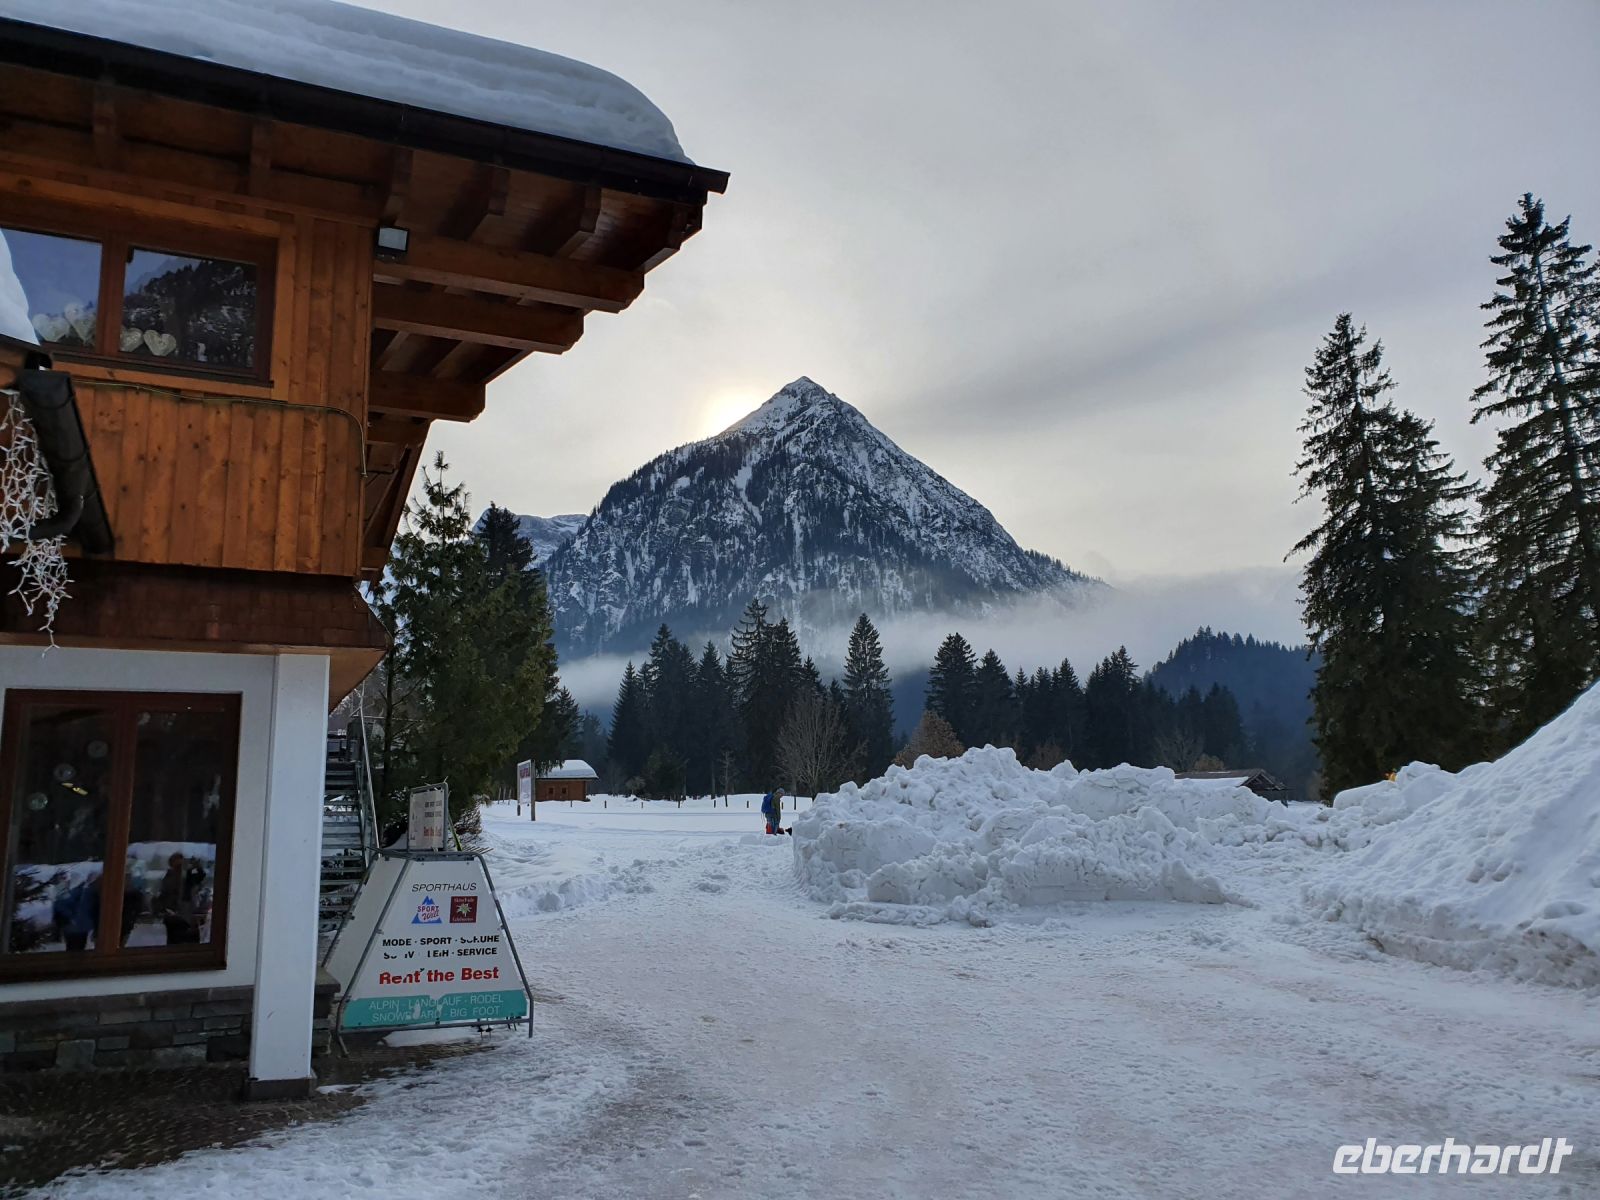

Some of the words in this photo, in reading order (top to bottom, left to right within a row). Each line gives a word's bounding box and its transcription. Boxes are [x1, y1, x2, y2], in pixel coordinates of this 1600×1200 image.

[412, 882, 477, 893] SPORTHAUS
[417, 905, 440, 913] SPORT
[382, 938, 412, 947] MODE
[420, 937, 452, 946] SPORT
[457, 947, 498, 957] SERVICE
[379, 970, 421, 985] Rent
[427, 969, 455, 983] the
[461, 966, 499, 981] Best
[368, 1001, 400, 1010] ALPIN
[470, 993, 504, 1005] RODEL
[450, 1007, 468, 1018] BIG
[473, 1005, 500, 1017] FOOT
